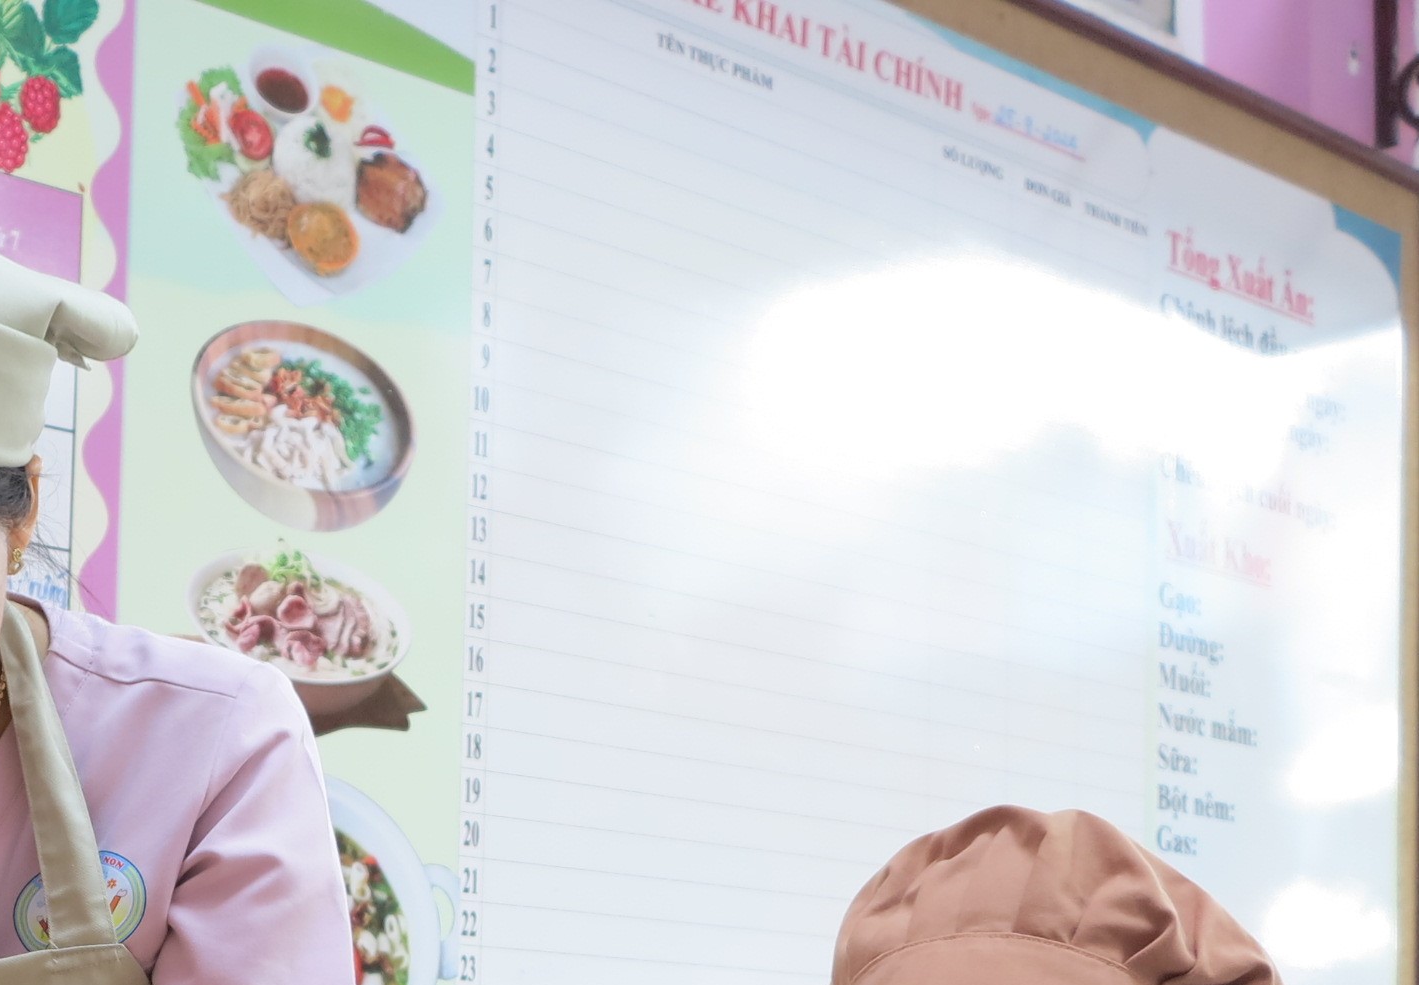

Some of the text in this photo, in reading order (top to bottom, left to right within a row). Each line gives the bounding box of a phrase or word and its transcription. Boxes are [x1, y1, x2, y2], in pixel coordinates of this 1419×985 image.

[488, 47, 496, 73] 2
[731, 0, 964, 111] KHAI TÀI CHÍNH
[487, 90, 496, 116] 3
[486, 133, 495, 158] 4
[485, 175, 494, 200] 5
[10, 228, 20, 250] 7
[484, 217, 493, 242] 6
[484, 258, 492, 284] 7
[482, 302, 491, 328] 8
[481, 343, 490, 369] 9
[473, 385, 489, 413] 10
[474, 430, 488, 458] 11
[471, 474, 487, 500] 12
[470, 516, 487, 542] 13
[469, 558, 486, 586] 14
[468, 602, 485, 630] 15
[468, 645, 484, 673] 16
[466, 691, 483, 718] 17
[465, 733, 482, 759] 18
[464, 777, 481, 803] 19
[463, 821, 480, 847] 20
[1156, 825, 1198, 855] Gas:
[103, 856, 124, 869] NON
[462, 867, 478, 894] 21
[461, 910, 477, 938] 22
[460, 955, 476, 982] 23
